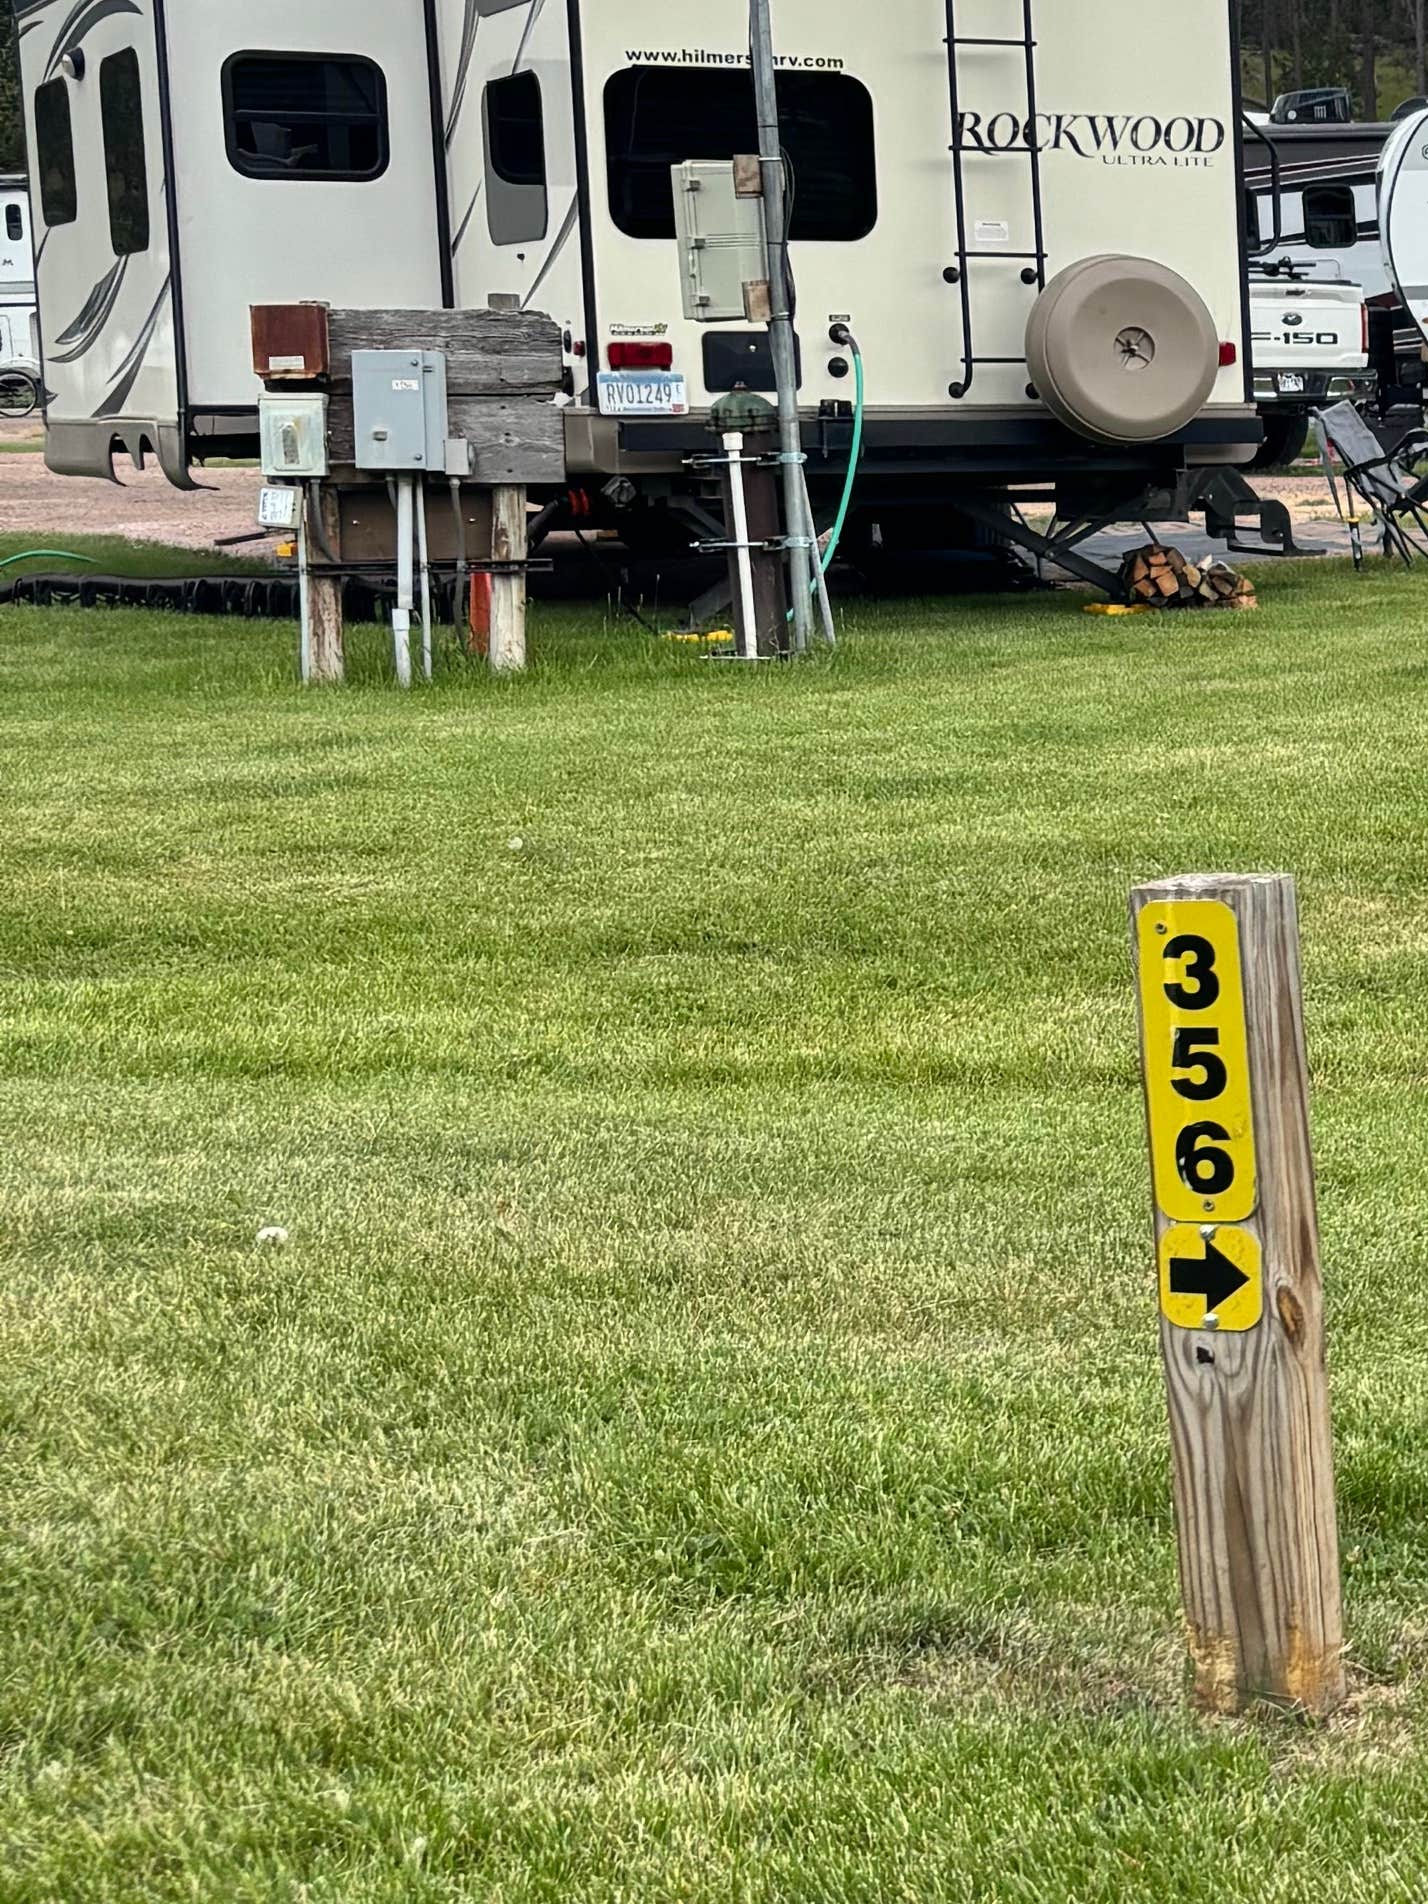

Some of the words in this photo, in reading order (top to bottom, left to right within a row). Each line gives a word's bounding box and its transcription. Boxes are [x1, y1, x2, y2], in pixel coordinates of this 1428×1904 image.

[957, 111, 1225, 159] ROCKWOOD
[1102, 154, 1168, 166] ULTRA
[1174, 156, 1214, 167] LITE
[606, 383, 672, 404] RV01249
[1163, 934, 1235, 1195] 356
